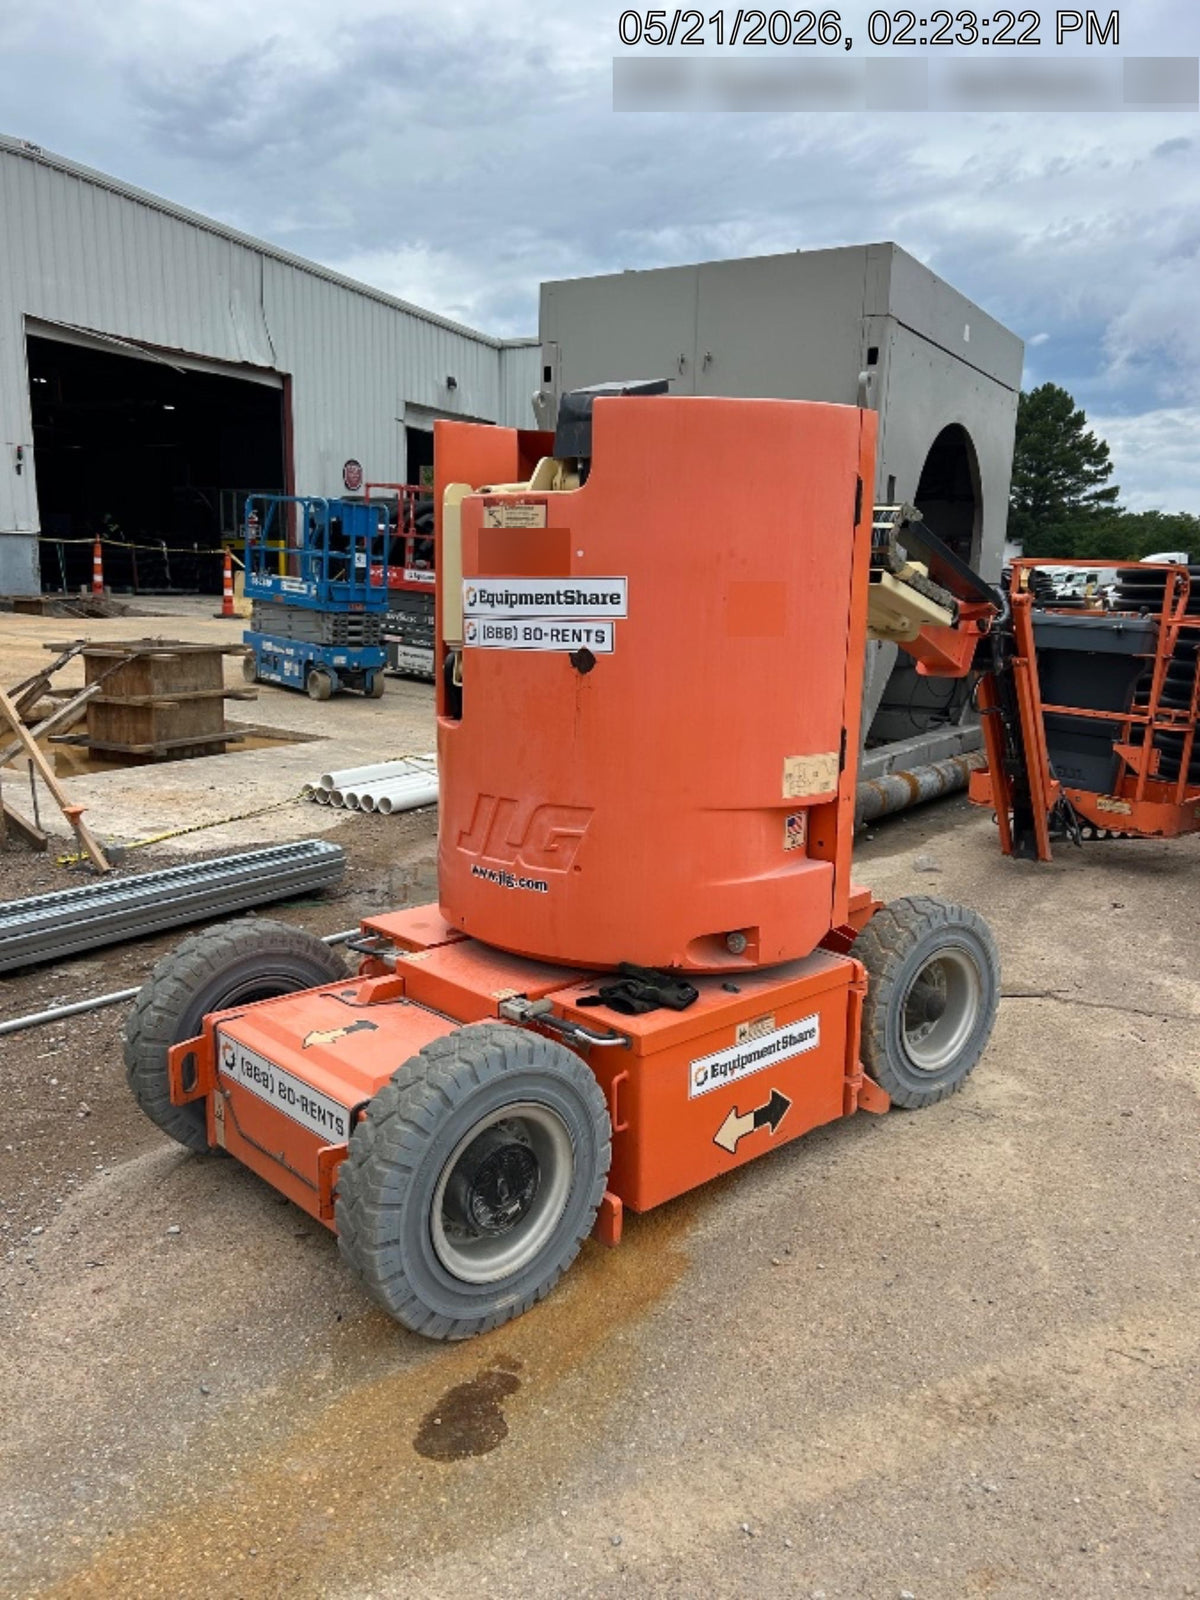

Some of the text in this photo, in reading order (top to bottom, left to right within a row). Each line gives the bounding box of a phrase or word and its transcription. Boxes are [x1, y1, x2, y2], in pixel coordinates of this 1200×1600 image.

[479, 590, 621, 608] EquipmentShare
[483, 626, 605, 644] (888) 80-RENTS
[457, 793, 595, 874] JLG
[472, 864, 548, 892] www.jlg.com
[711, 1027, 816, 1079] EquipmentShare
[241, 1056, 344, 1137] (888) 80-RENTS
